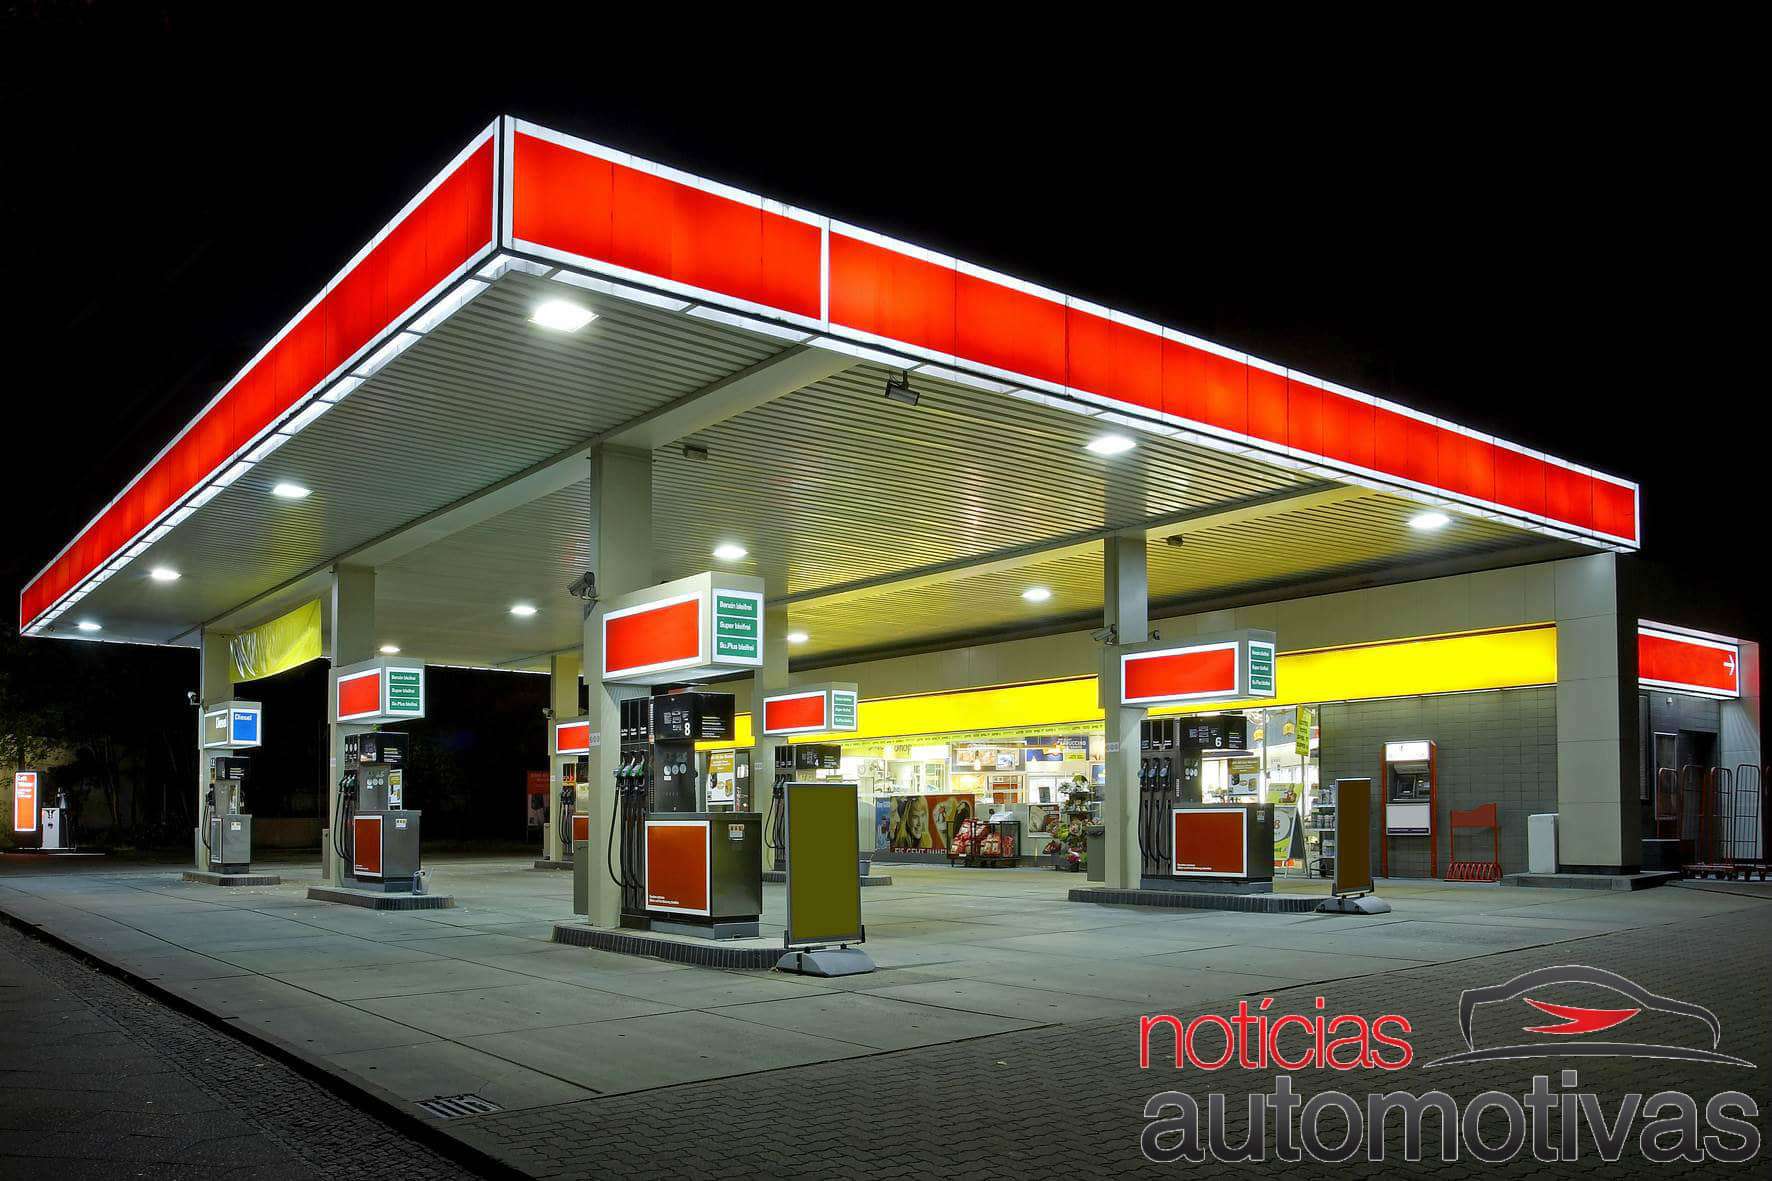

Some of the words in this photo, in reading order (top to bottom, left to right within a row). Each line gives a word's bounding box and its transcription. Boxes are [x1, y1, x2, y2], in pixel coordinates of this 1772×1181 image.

[719, 620, 735, 630] Super
[234, 713, 253, 721] Diesel
[684, 722, 691, 736] 8
[1215, 736, 1222, 748] 6
